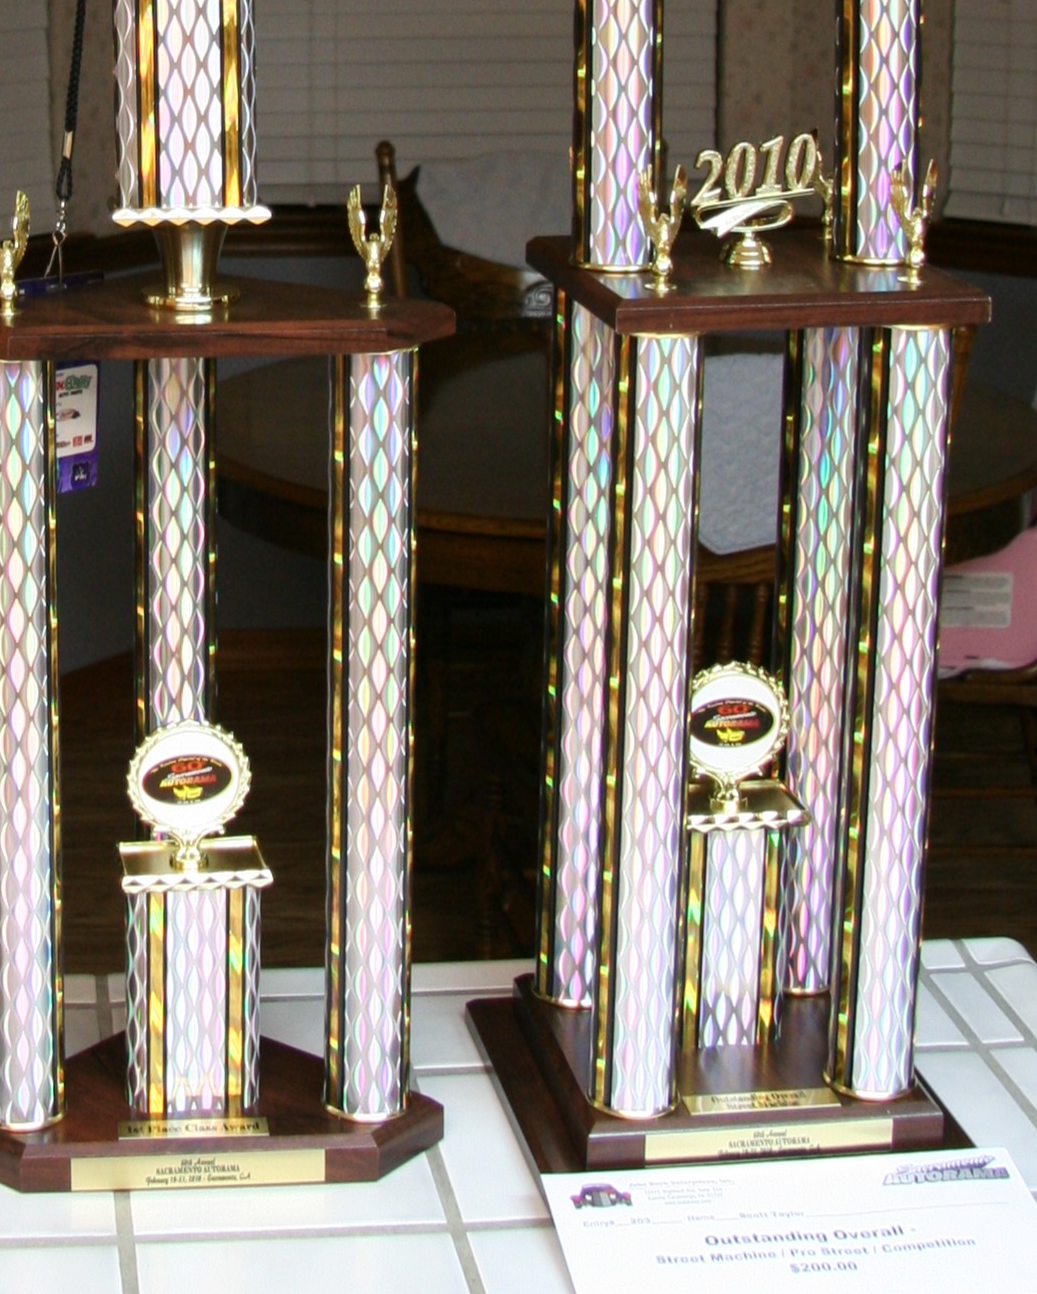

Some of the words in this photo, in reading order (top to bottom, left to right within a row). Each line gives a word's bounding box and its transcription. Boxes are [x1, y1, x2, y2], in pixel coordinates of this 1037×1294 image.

[691, 134, 817, 205] 2010
[148, 1123, 182, 1133] Place
[185, 1122, 217, 1132] Class
[222, 1122, 259, 1131] Award
[729, 1138, 773, 1148] SACRAMENTO
[775, 1136, 810, 1145] AUTORAMA
[156, 1165, 202, 1175] SACRAMENTO
[203, 1164, 240, 1173] AUTORAMA
[882, 1167, 1010, 1187] AUTORAMA
[630, 1217, 651, 1225] 203
[687, 1214, 715, 1222] Name
[739, 1211, 769, 1219] Scott
[771, 1210, 805, 1219] Taylor
[704, 1230, 828, 1247] Outstanding
[833, 1225, 905, 1241] Overall
[656, 1253, 705, 1265] Street
[710, 1249, 777, 1263] Machine
[790, 1246, 816, 1258] Pro
[821, 1246, 868, 1257] Street
[882, 1237, 977, 1254] Competition
[789, 1261, 858, 1274] $200.00
